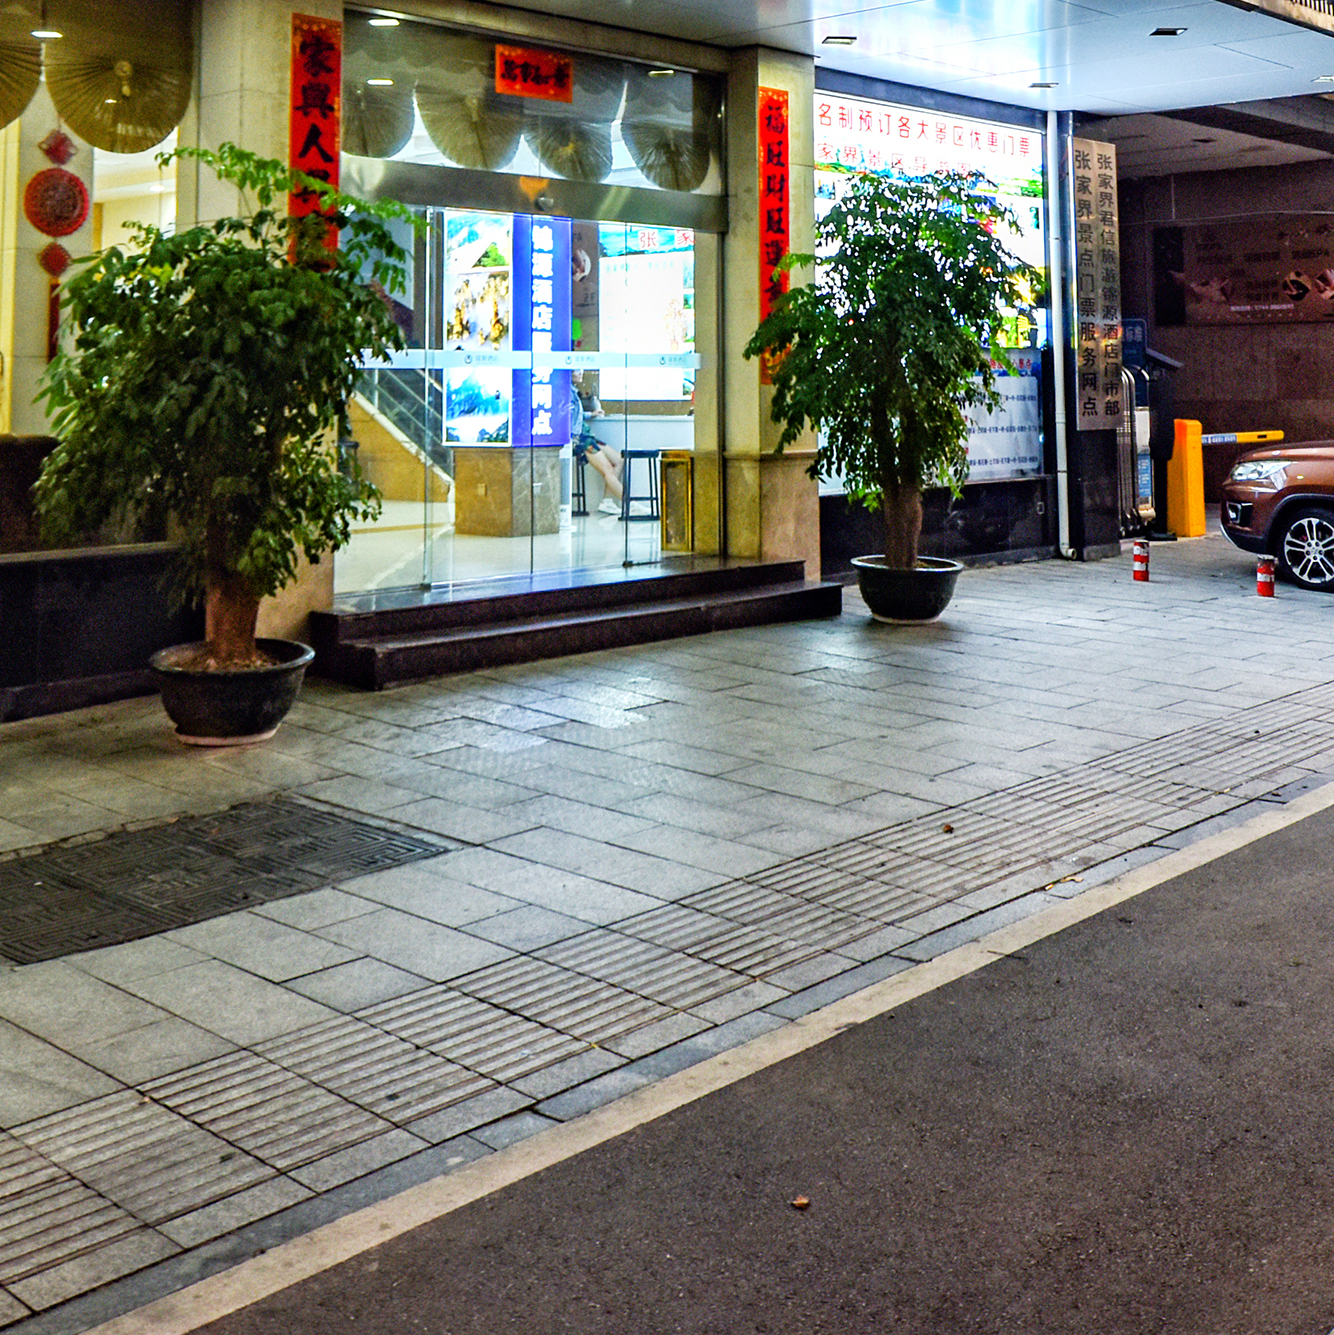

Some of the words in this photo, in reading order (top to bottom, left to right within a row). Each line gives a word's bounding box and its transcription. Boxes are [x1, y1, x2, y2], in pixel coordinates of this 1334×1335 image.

[818, 102, 1030, 158] 名制预订各大景区优惠门票
[1074, 150, 1098, 417] 张家界景点门票服务网点
